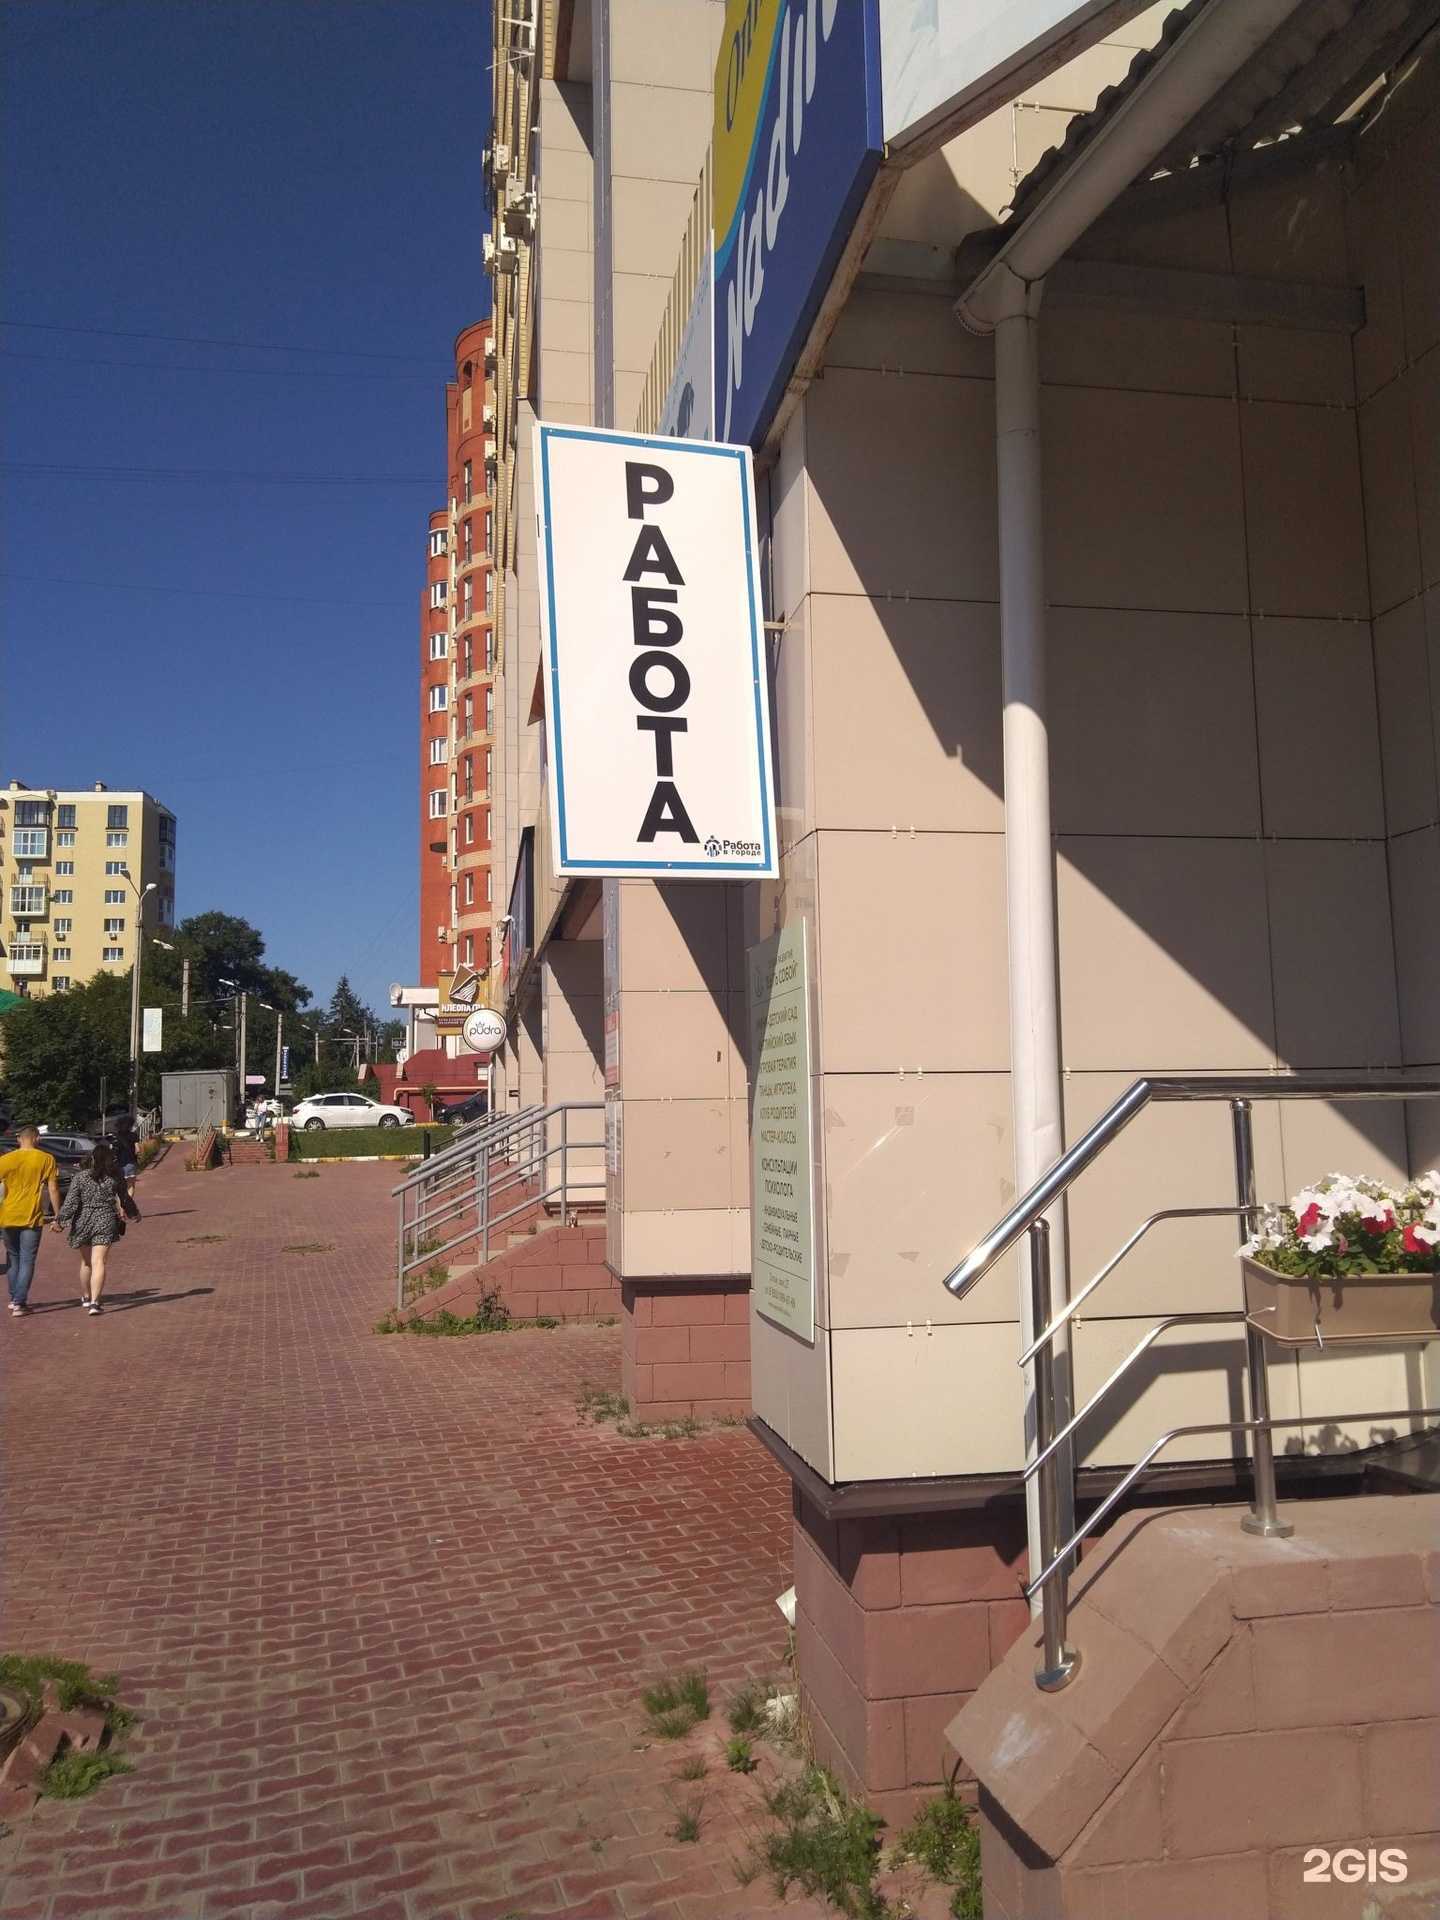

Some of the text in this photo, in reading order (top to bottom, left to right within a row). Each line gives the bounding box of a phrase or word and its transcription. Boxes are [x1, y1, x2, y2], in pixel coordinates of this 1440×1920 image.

[623, 462, 701, 844] РАБОТА
[723, 839, 761, 850] Работа
[731, 849, 761, 857] городе
[469, 1024, 501, 1037] pudra
